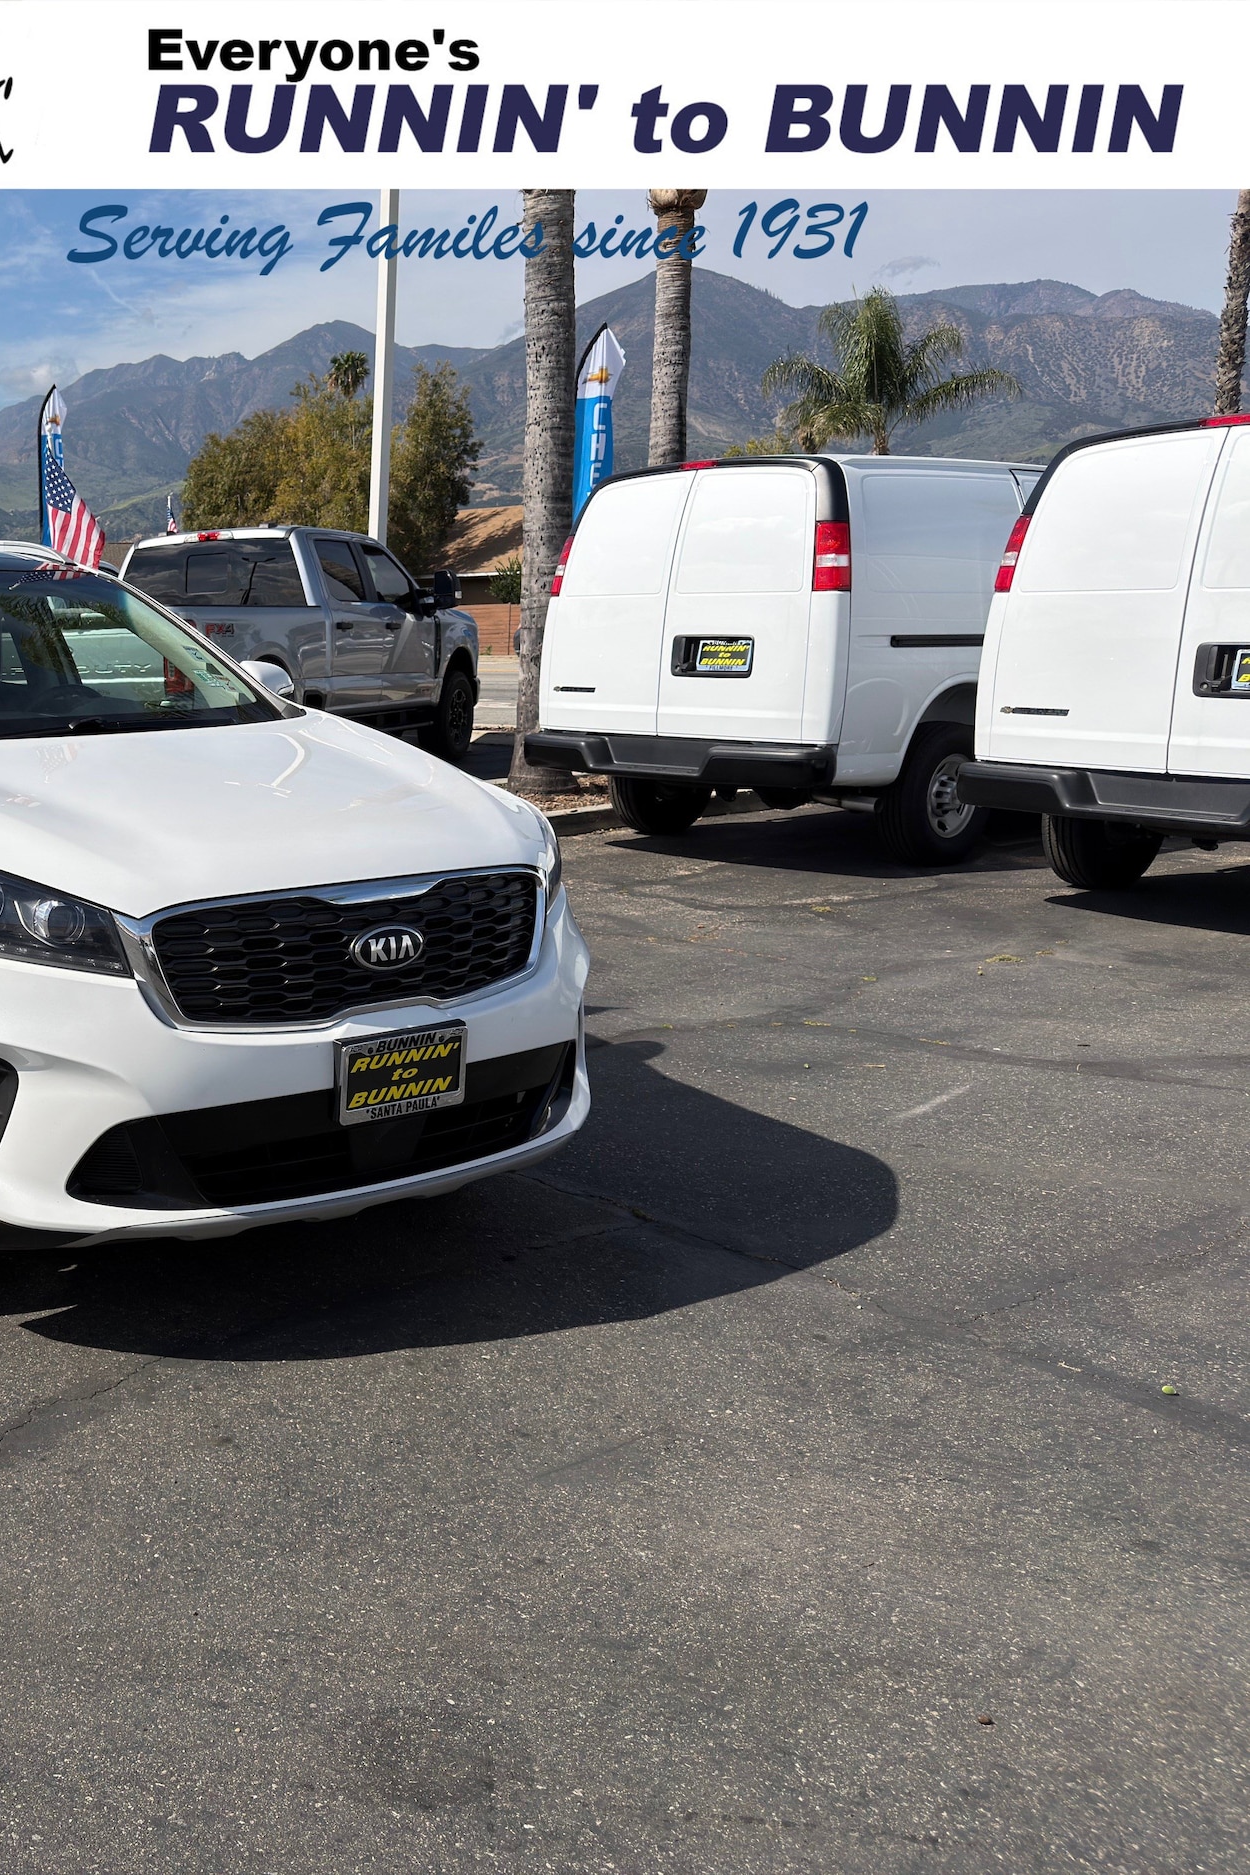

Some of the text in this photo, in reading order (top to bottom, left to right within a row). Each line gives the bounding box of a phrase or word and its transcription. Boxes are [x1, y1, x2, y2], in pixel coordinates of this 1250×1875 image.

[587, 402, 608, 496] CHE
[205, 624, 235, 637] FX4
[700, 658, 745, 666] BUNNIN
[367, 934, 415, 963] KIA
[376, 1032, 437, 1053] BUNNIN
[350, 1042, 460, 1074] RUNNIN'
[391, 1068, 418, 1081] to
[348, 1076, 453, 1109] BUNNIN
